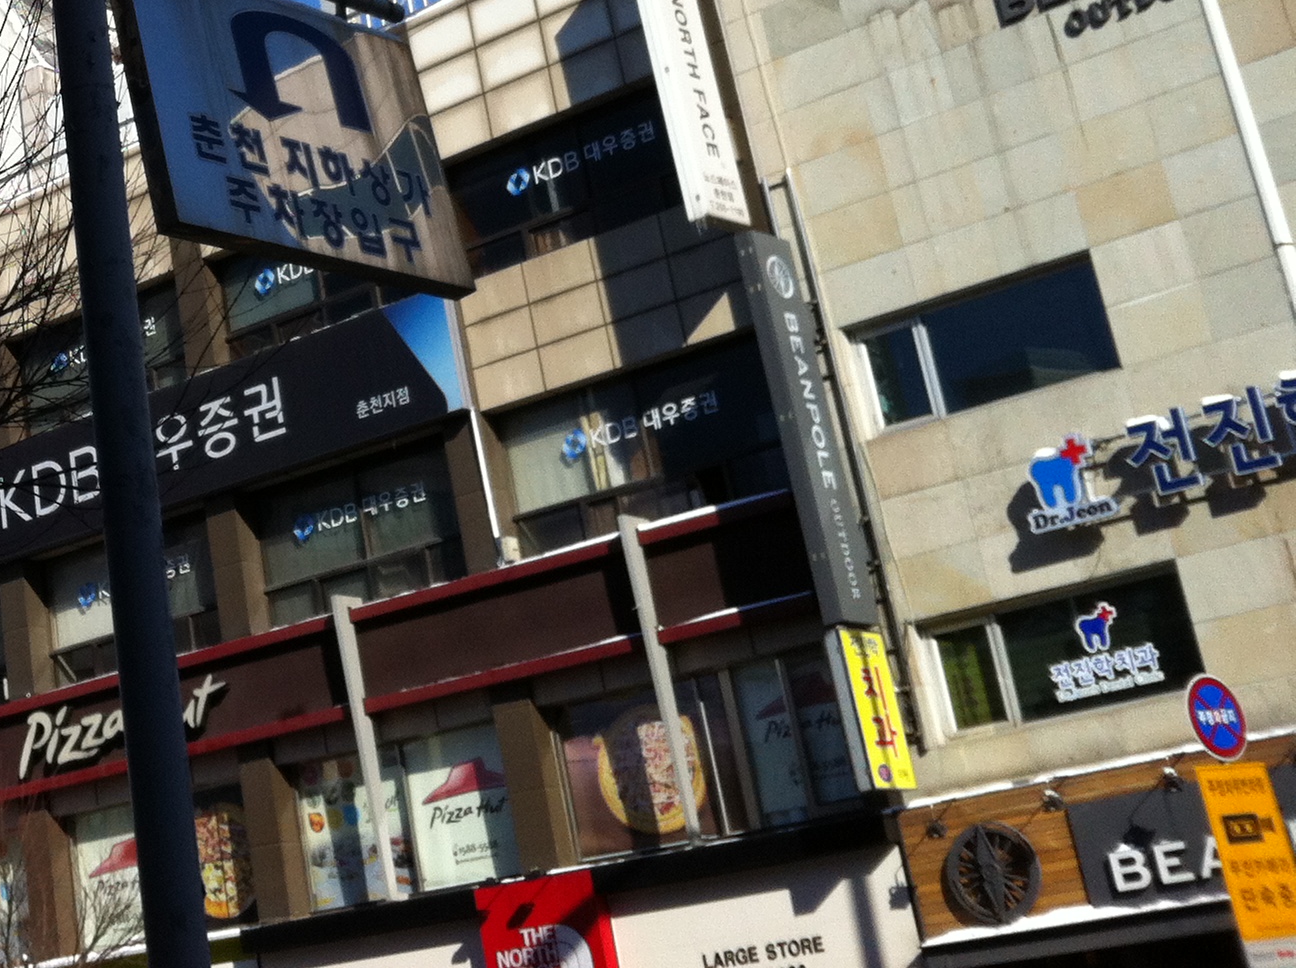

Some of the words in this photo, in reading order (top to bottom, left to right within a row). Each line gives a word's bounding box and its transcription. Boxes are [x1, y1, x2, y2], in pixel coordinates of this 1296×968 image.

[694, 87, 721, 159] FACE
[188, 112, 270, 177] 춘천
[280, 143, 431, 218] 지하상가
[532, 150, 580, 184] KDB
[582, 121, 655, 162] 대우증권
[227, 176, 422, 265] 주차장입구
[155, 376, 286, 472] 우증권
[355, 387, 410, 420] 춘천지점
[589, 412, 637, 446] KDB
[642, 388, 718, 430] 대우증권
[783, 310, 836, 493] BEANPOLE
[315, 500, 358, 532] KDB
[1034, 498, 1114, 530] Dr.Jeon
[1051, 644, 1160, 690] 전진학치과
[19, 705, 125, 780] Pizza
[183, 674, 229, 729] ut
[429, 803, 472, 829] Pizza
[476, 796, 509, 818] Hut
[519, 924, 553, 946] THE
[702, 946, 758, 968] LARGE
[765, 936, 824, 960] STORE
